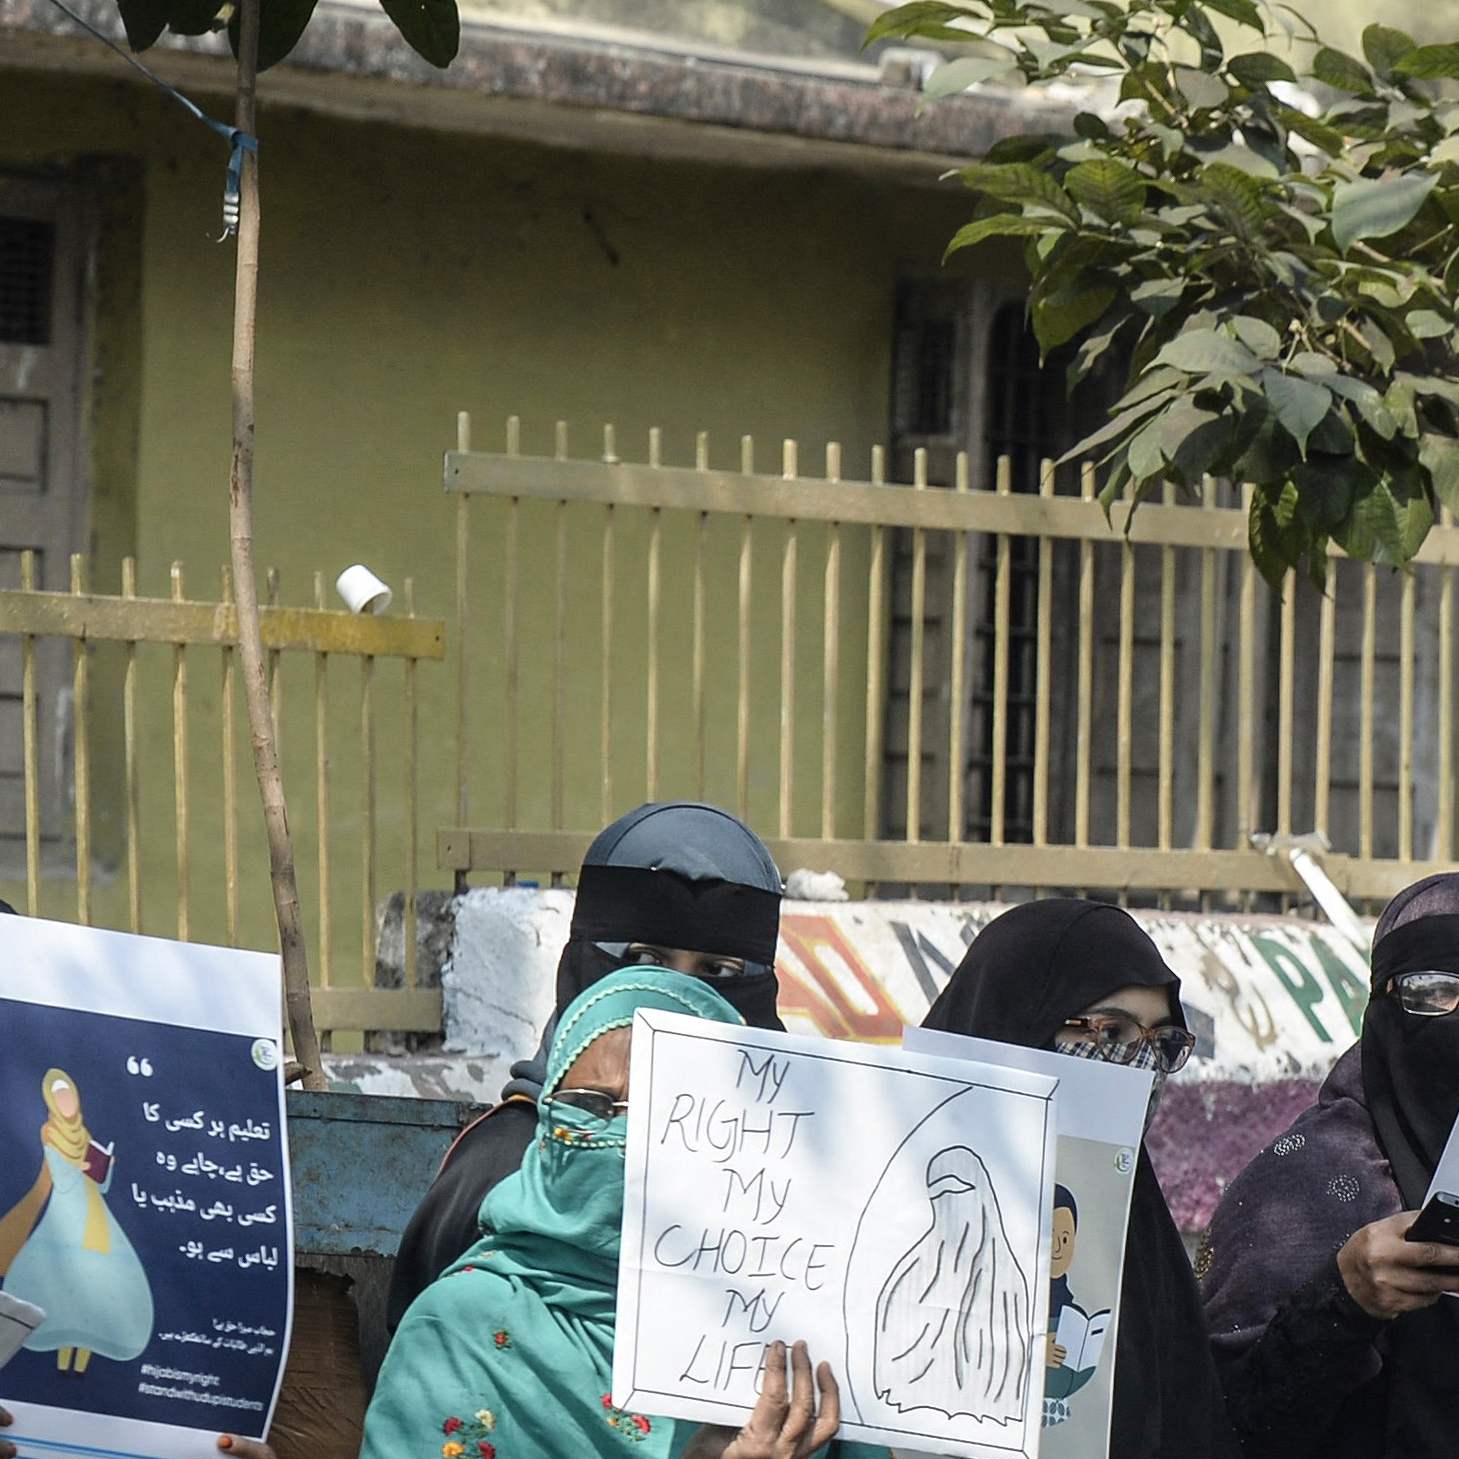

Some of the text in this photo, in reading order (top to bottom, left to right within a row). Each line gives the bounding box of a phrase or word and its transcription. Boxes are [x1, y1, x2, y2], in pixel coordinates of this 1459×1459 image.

[735, 1049, 791, 1104] MY
[143, 1102, 271, 1142] تعلیم ہر کسی کا
[660, 1093, 815, 1164] RIGHT
[156, 1151, 274, 1186] حق وہ
[132, 1182, 276, 1226] کسی بھی مذہب یا
[721, 1167, 792, 1226] MY
[206, 1247, 234, 1263] سے
[238, 1245, 278, 1272] لباس
[654, 1223, 835, 1291] CHOICE
[721, 1288, 785, 1333] MY
